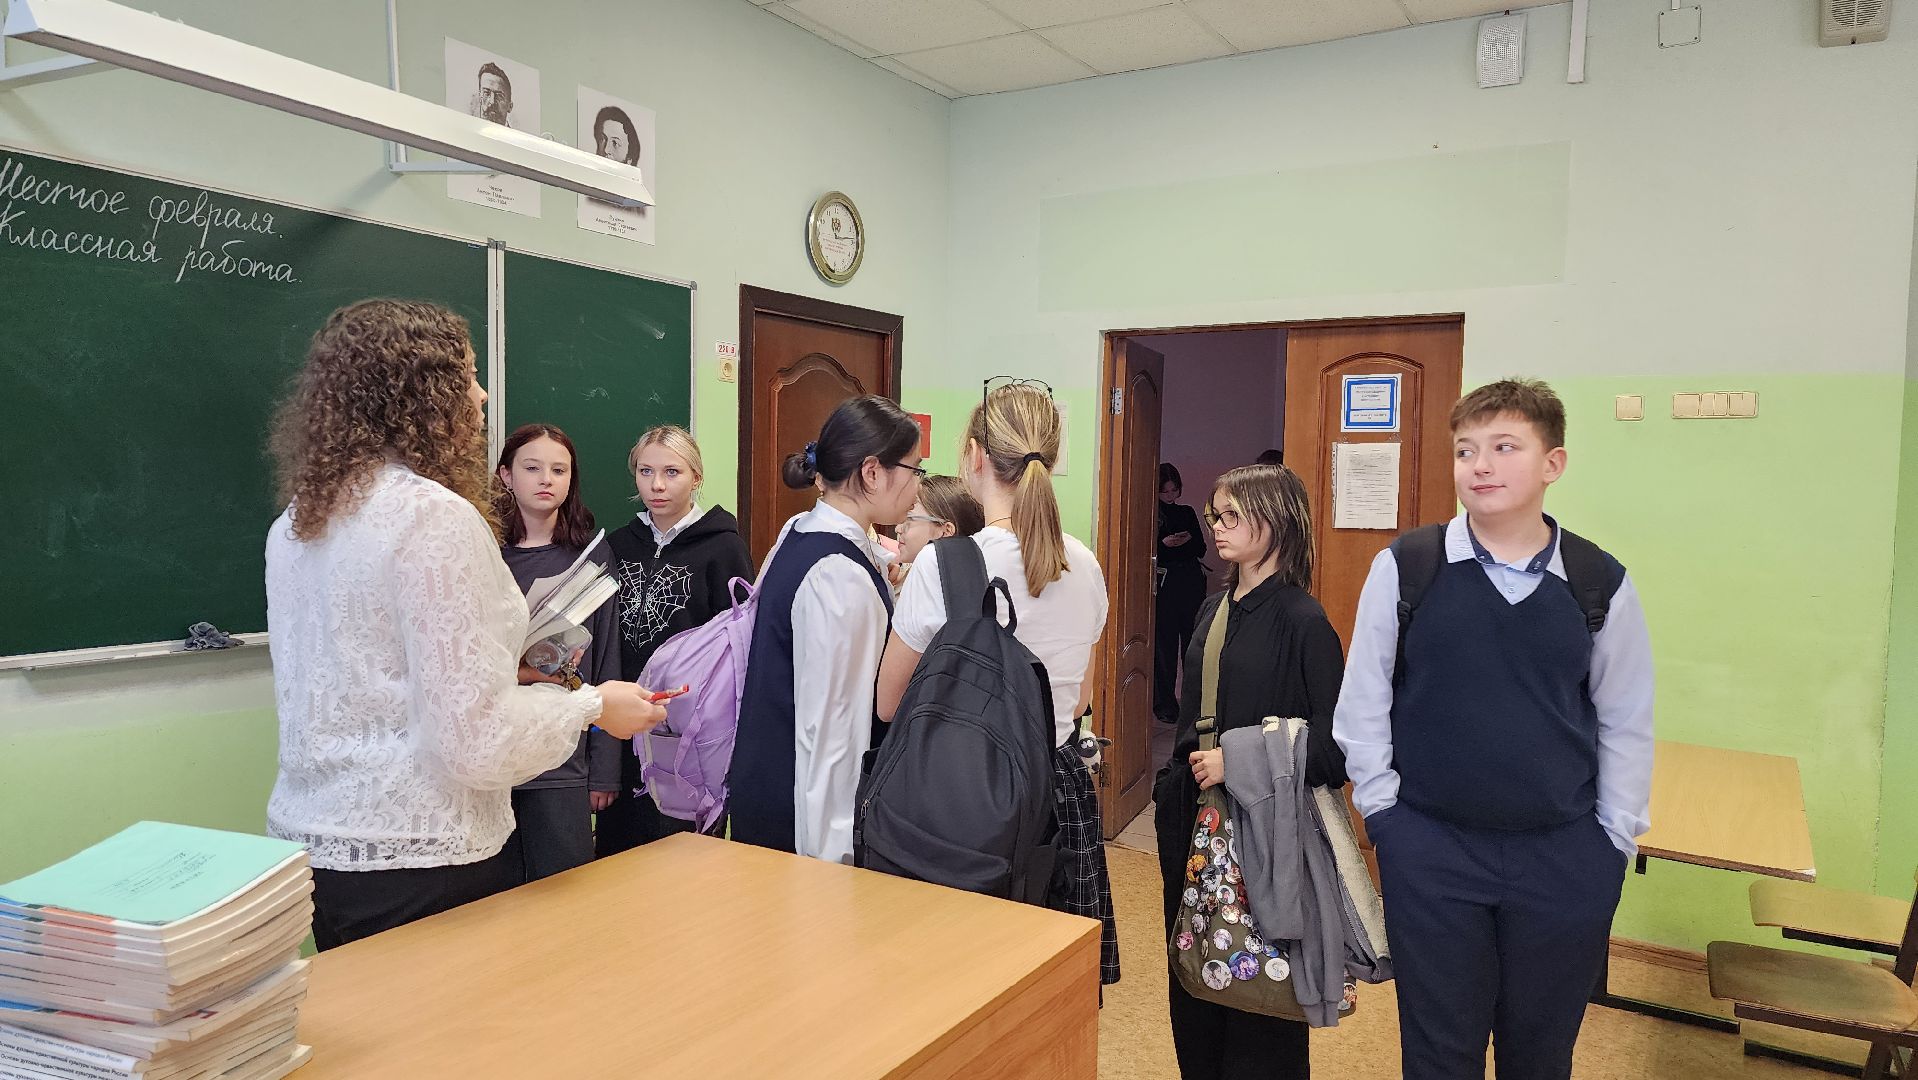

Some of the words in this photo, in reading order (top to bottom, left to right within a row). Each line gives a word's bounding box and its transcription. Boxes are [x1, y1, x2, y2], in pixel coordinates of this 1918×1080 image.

[0, 200, 163, 263] Классная
[175, 239, 303, 284] работа.
[149, 190, 283, 249] февраля.
